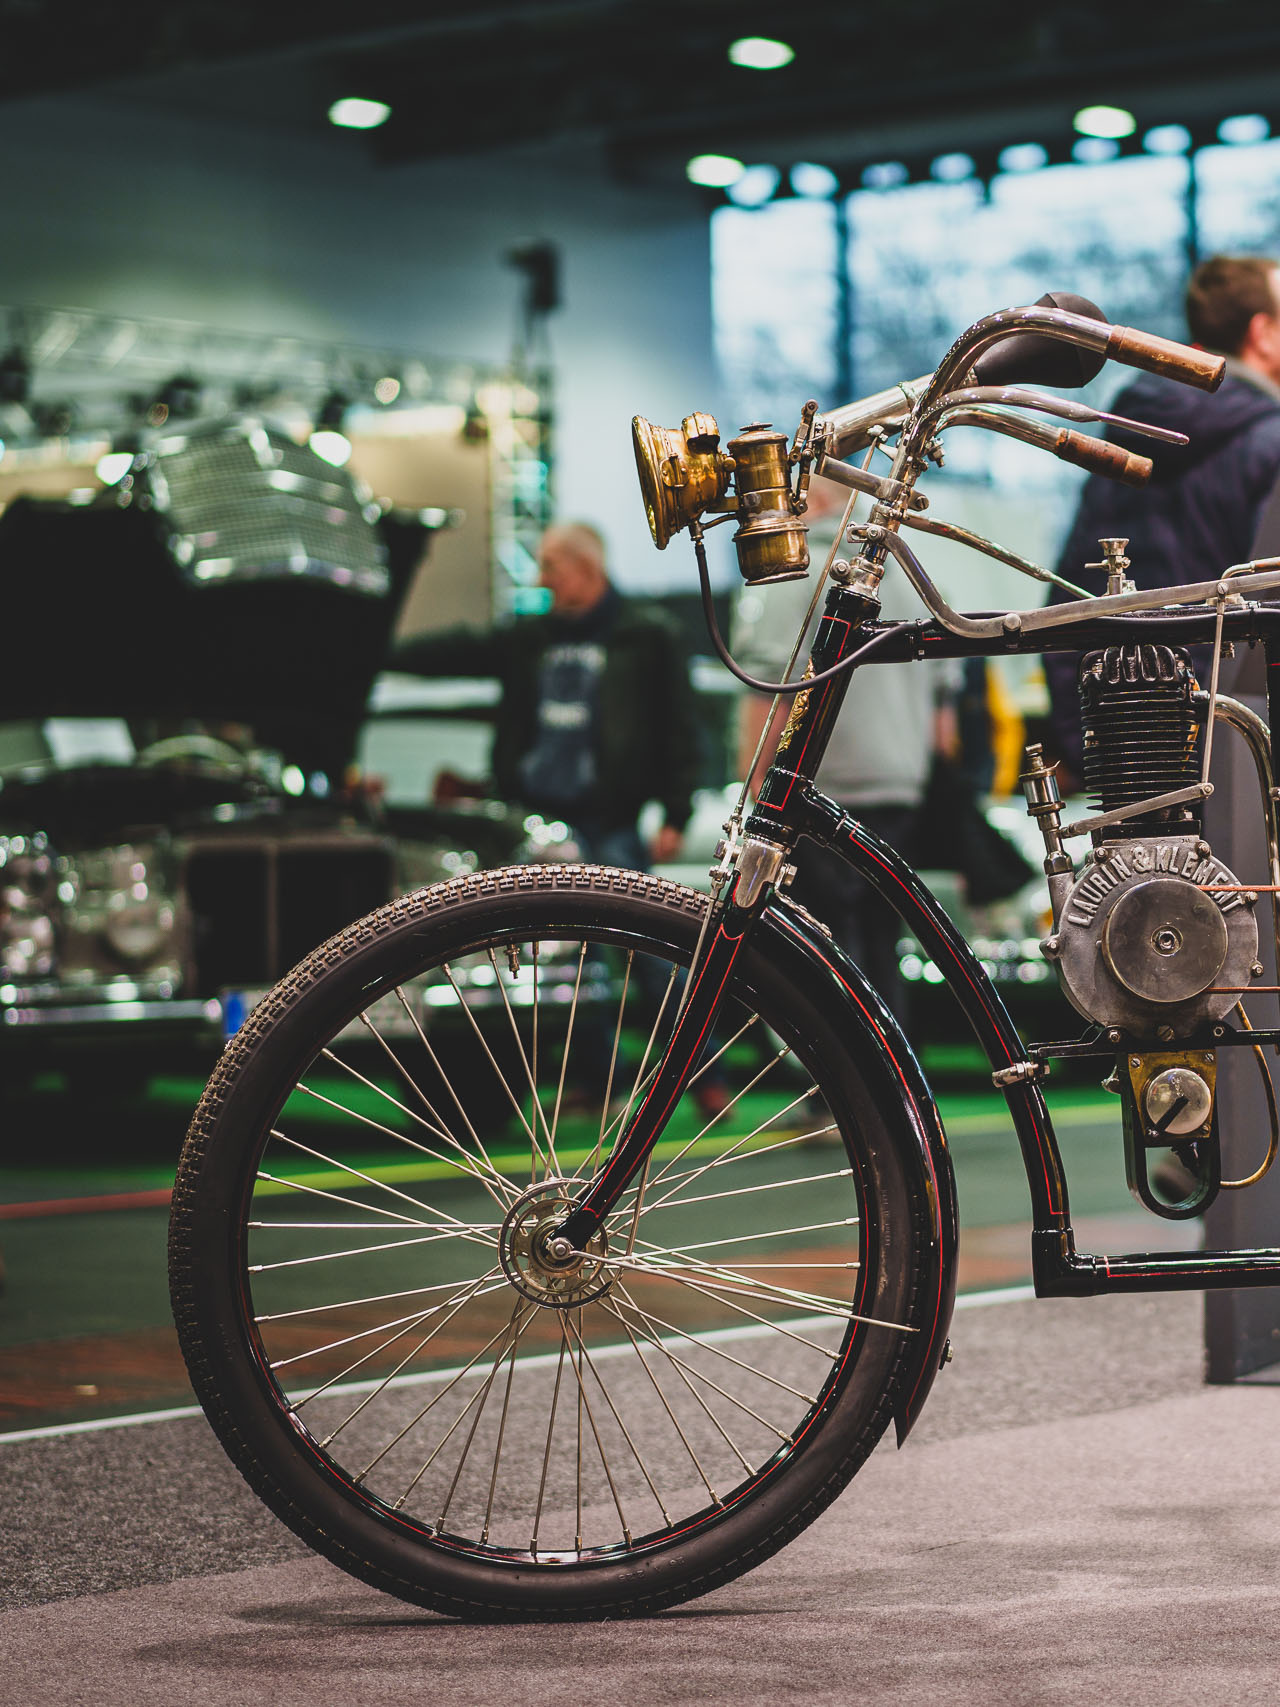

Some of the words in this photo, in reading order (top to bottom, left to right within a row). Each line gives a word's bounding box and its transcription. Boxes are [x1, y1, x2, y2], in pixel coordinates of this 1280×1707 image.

[1067, 854, 1132, 927] LAURIN
[1133, 846, 1154, 874] &
[1154, 845, 1246, 913] KLEMENT
